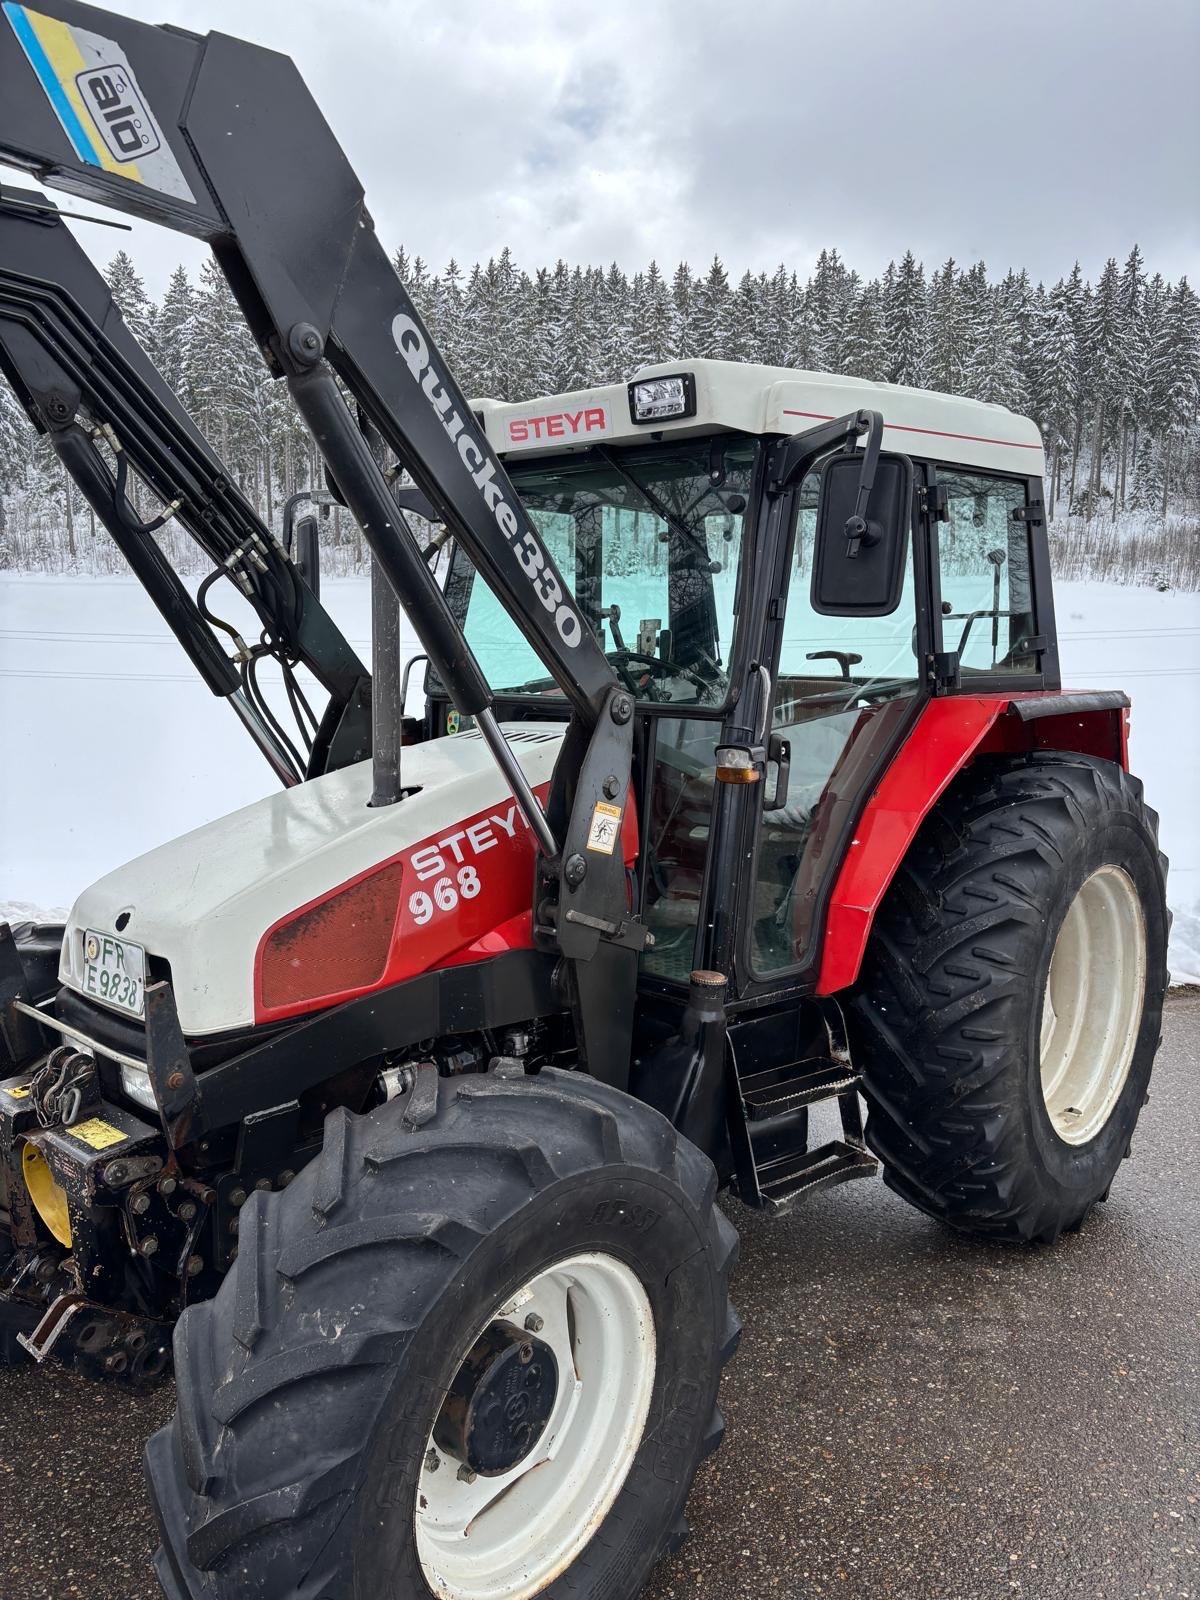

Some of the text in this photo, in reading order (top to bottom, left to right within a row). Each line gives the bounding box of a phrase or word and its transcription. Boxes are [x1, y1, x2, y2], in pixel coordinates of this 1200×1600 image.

[509, 407, 606, 442] STEYR
[391, 313, 582, 648] Quicke 330
[408, 865, 481, 925] 968
[102, 938, 126, 972] FR
